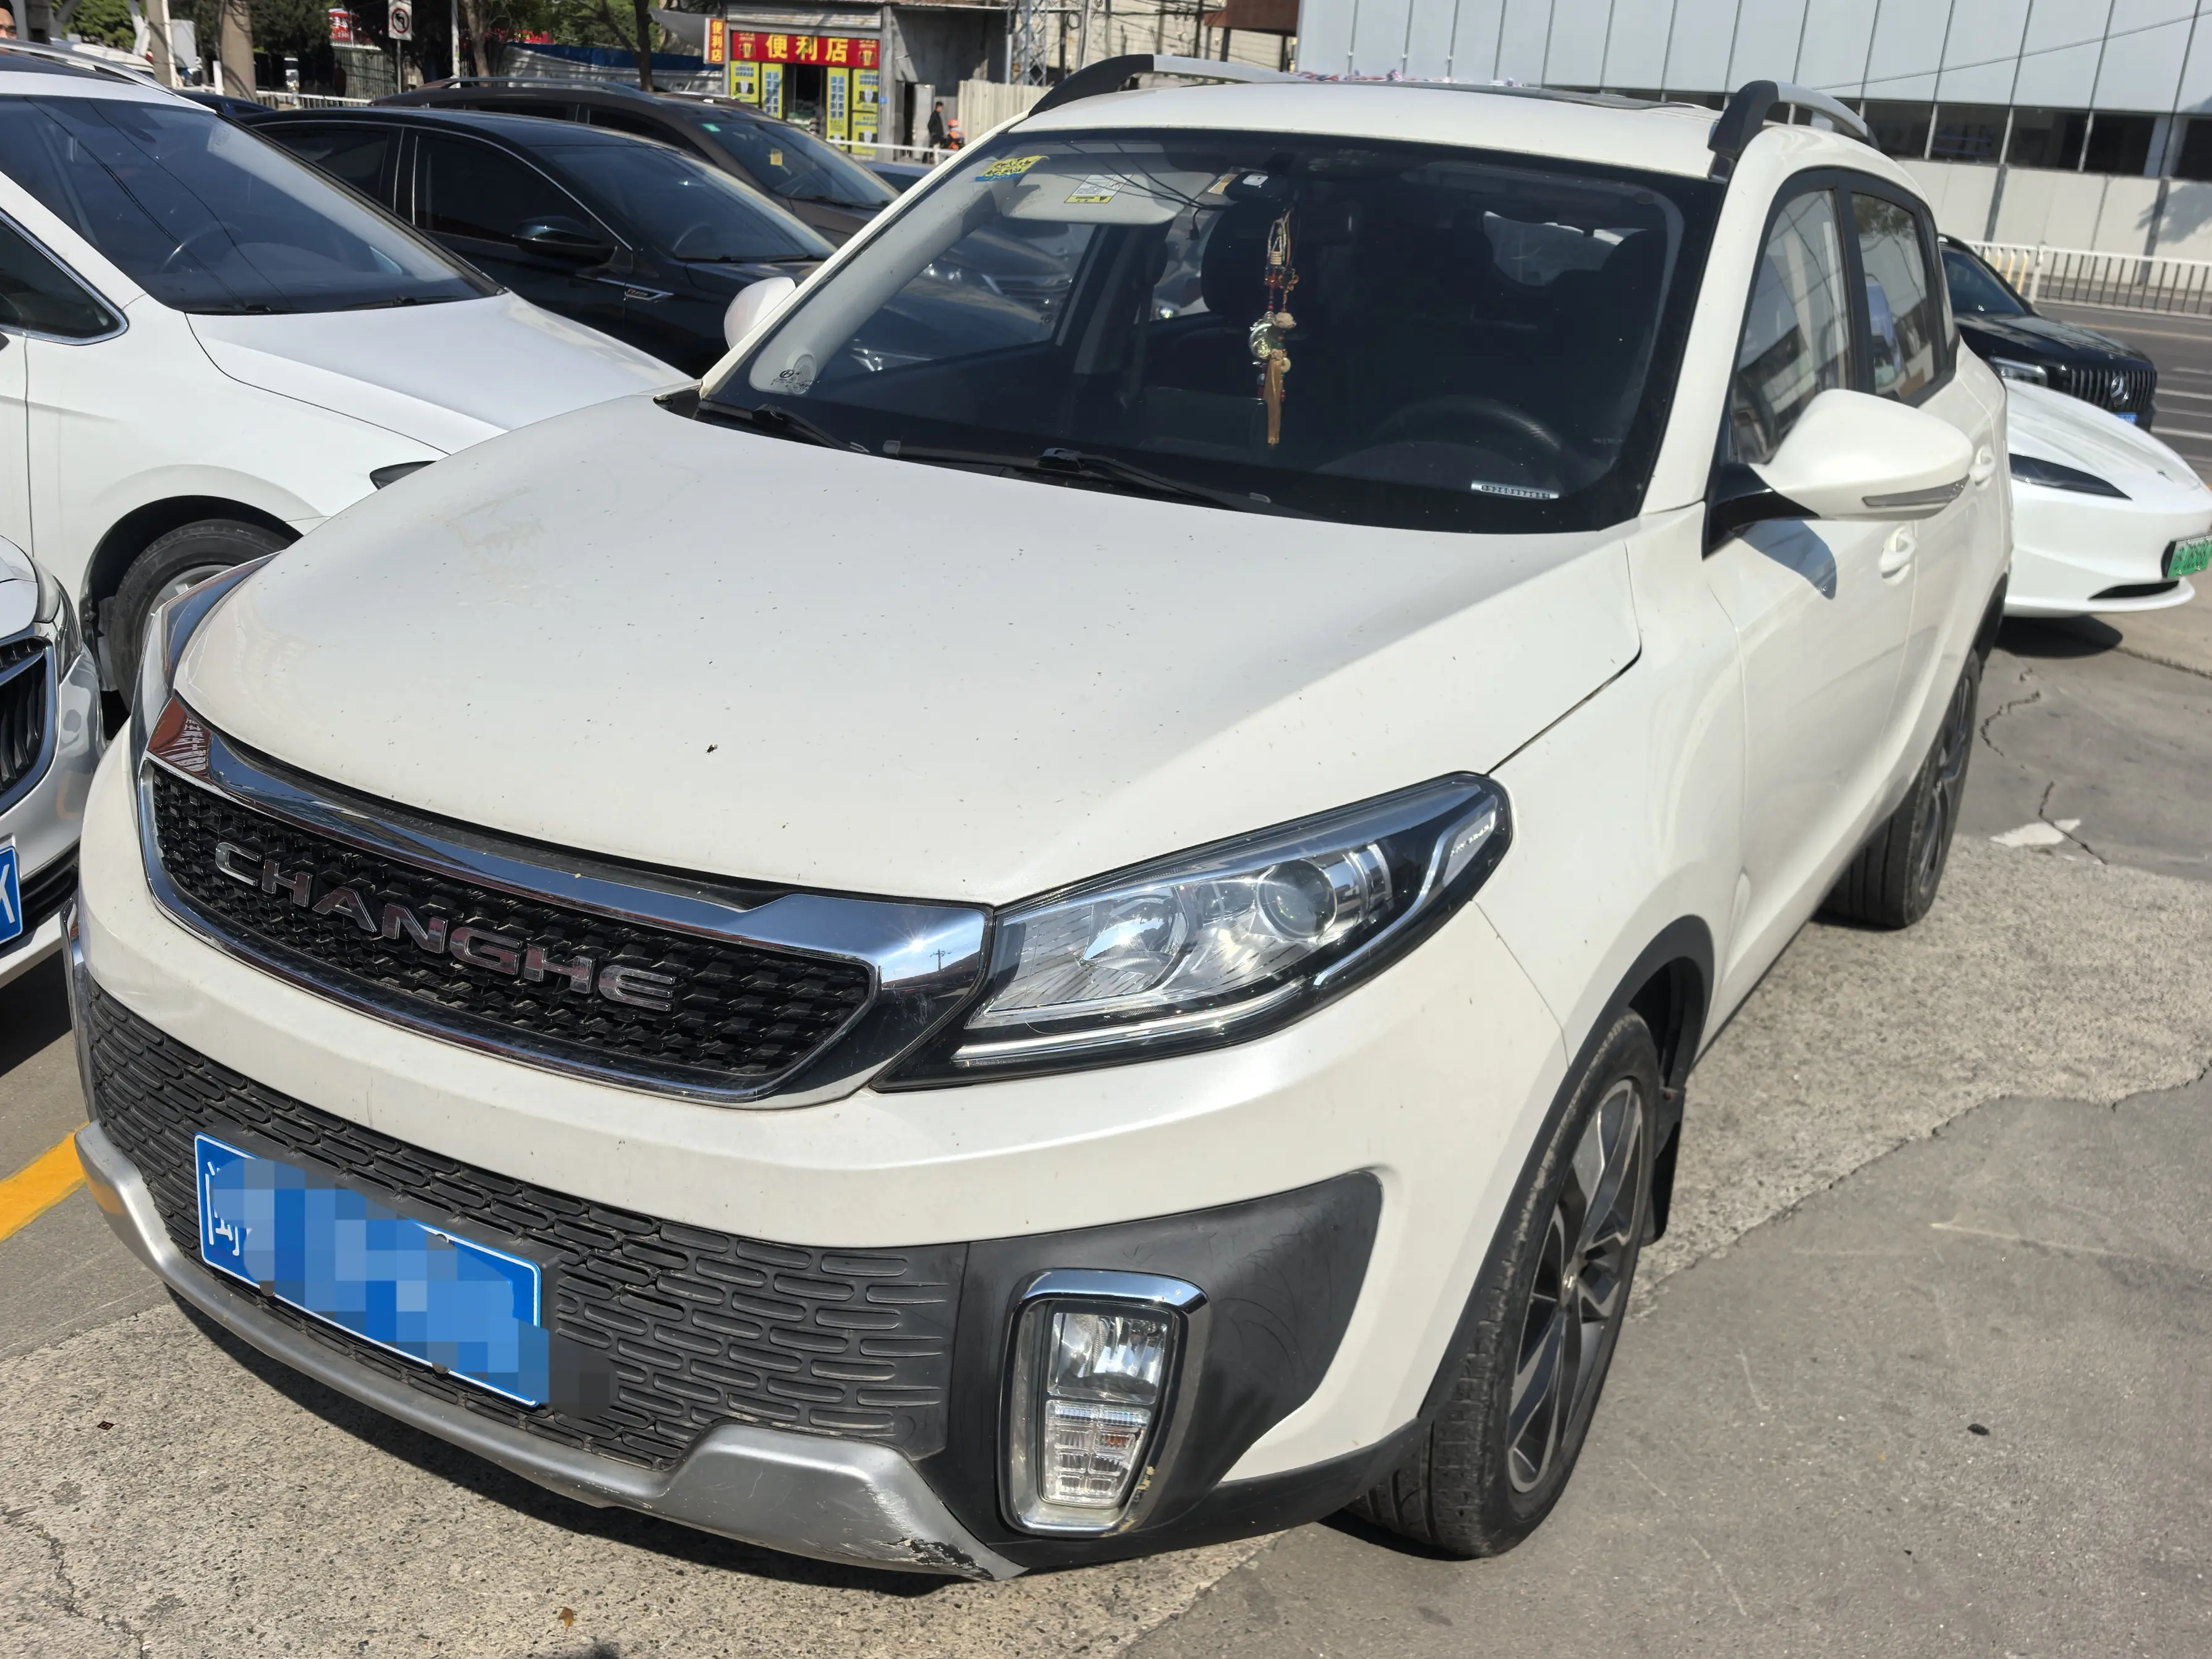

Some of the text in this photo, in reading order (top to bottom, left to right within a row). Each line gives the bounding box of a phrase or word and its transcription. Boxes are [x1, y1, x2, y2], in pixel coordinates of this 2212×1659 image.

[712, 21, 723, 62] 便利店
[765, 34, 848, 63] 便利店
[215, 841, 682, 1013] CHANGHE
